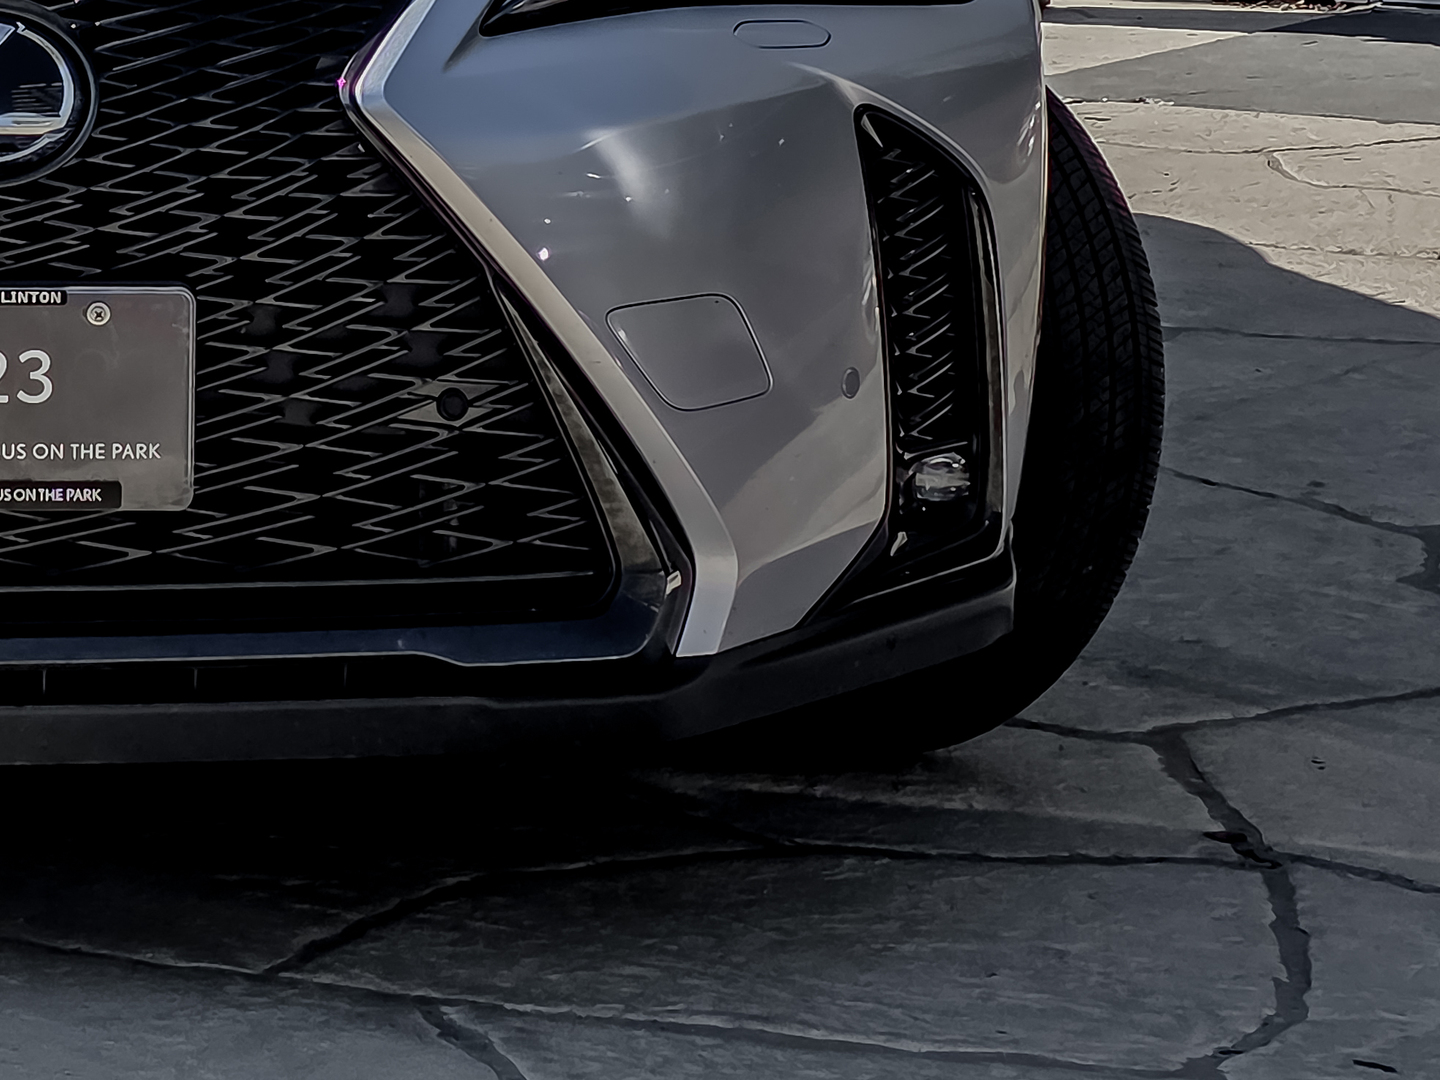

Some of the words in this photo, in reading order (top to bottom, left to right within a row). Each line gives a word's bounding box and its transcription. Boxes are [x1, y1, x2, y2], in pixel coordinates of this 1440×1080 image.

[32, 443, 64, 460] ON
[70, 443, 106, 460] THE
[112, 442, 161, 460] PARK
[13, 488, 36, 502] ON
[38, 488, 64, 502] THE
[66, 488, 102, 502] PARK
